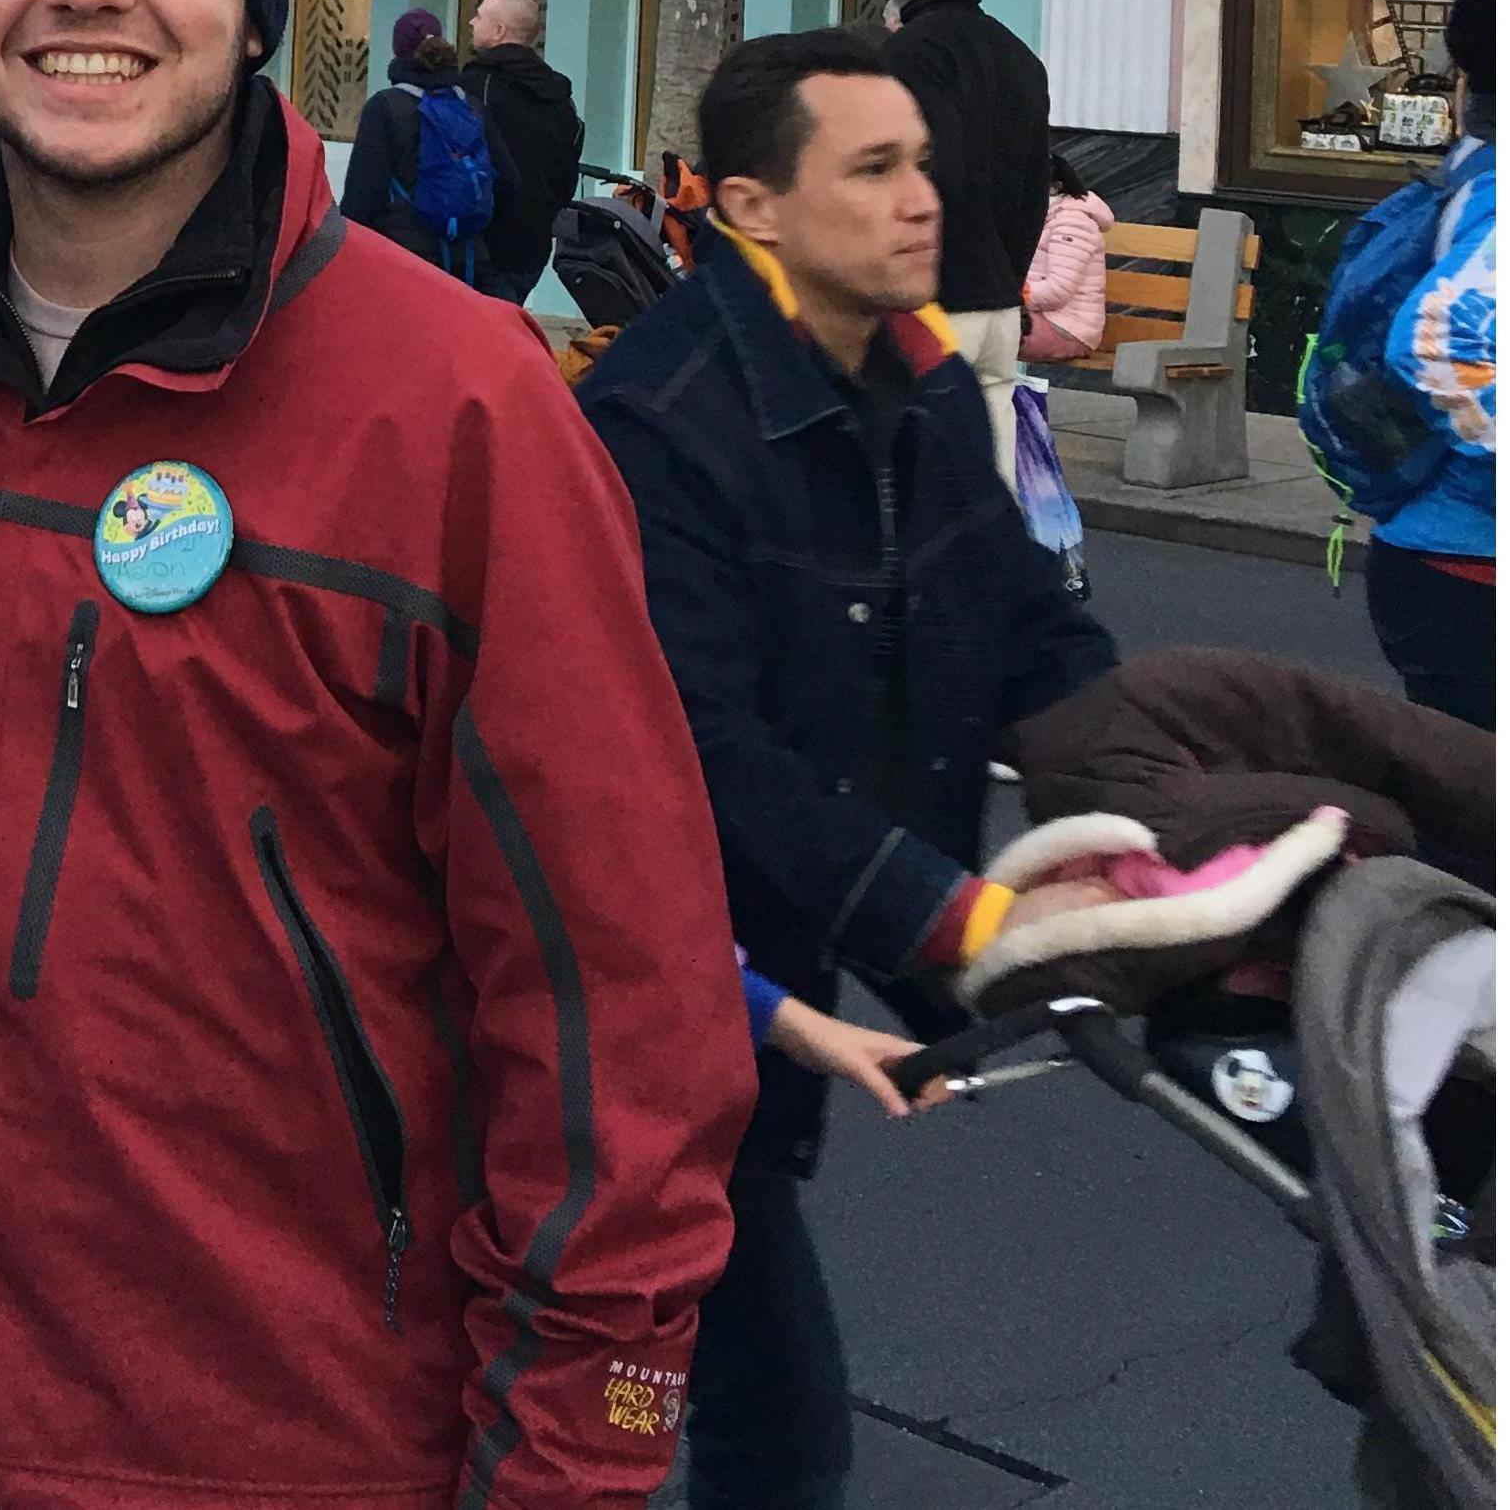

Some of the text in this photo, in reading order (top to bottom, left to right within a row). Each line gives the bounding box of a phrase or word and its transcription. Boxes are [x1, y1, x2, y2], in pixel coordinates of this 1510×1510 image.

[101, 519, 220, 564] Happy Birthday!
[117, 561, 186, 581] Aaron
[605, 1378, 655, 1408] HARD
[609, 1403, 659, 1436] WEAR
